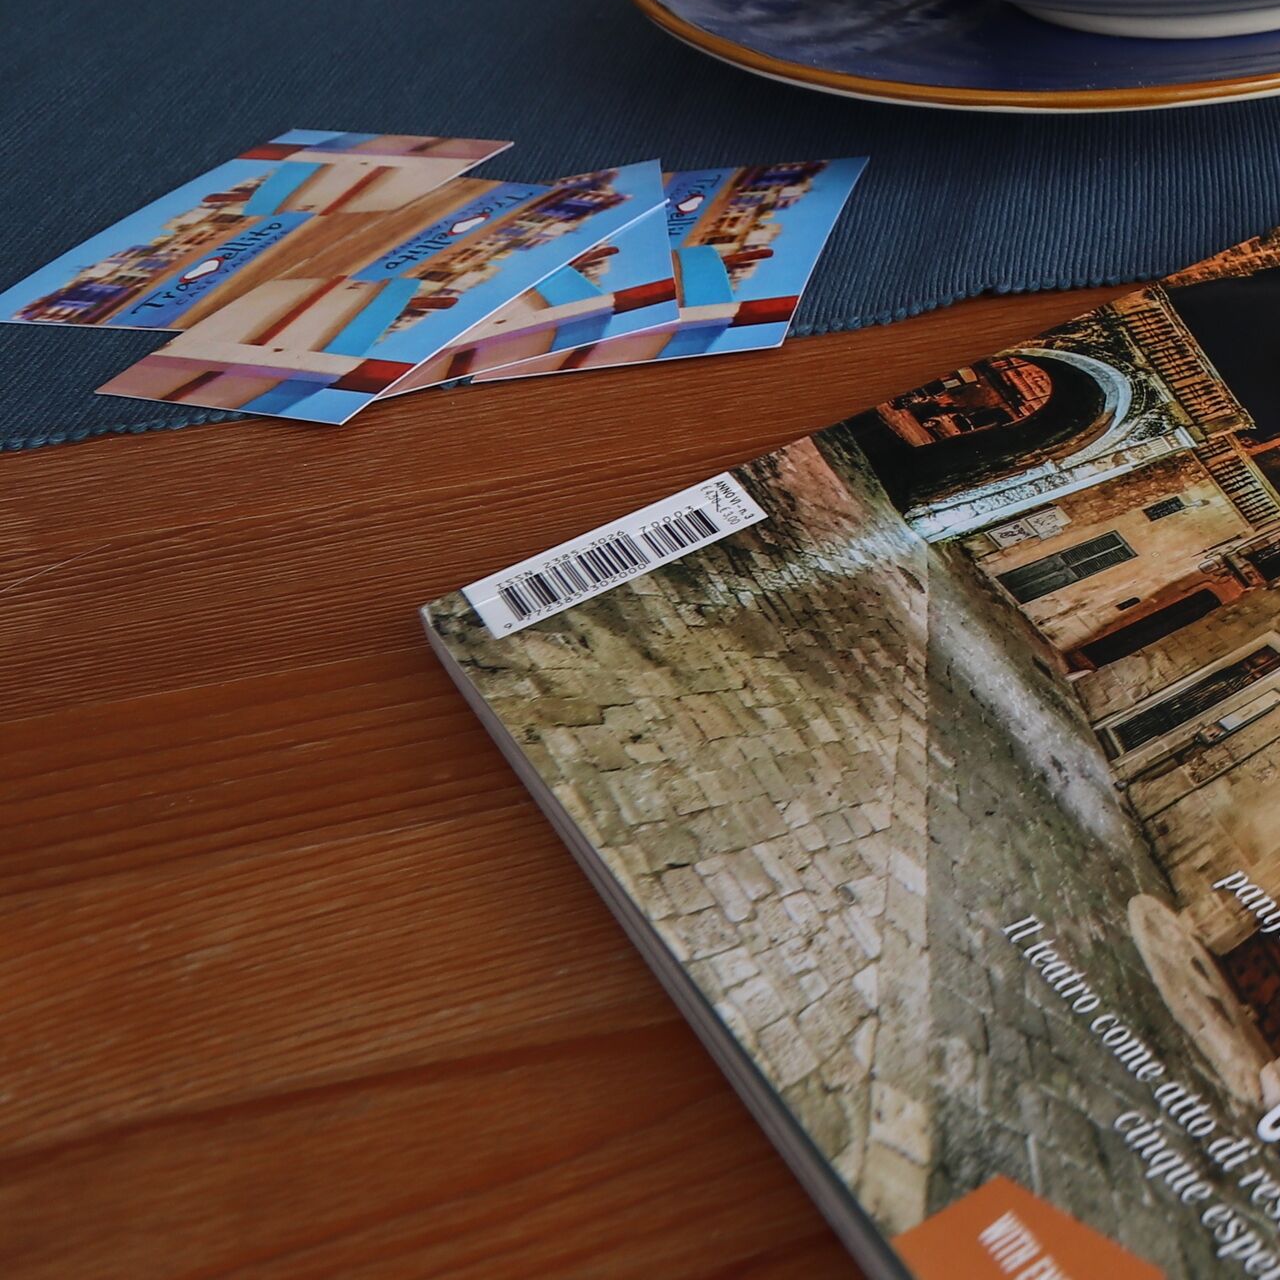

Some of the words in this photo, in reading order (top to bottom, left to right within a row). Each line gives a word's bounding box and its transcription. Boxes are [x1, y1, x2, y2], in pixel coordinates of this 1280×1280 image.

[495, 570, 535, 591] ISSN
[544, 529, 626, 569] 2385-3026
[1002, 914, 1045, 944] Il
[1024, 939, 1102, 1015] teatro
[1090, 1013, 1167, 1083] come
[1154, 1080, 1217, 1138] atto
[1206, 1134, 1262, 1172] di
[1113, 1109, 1213, 1205] cinque
[977, 1209, 1043, 1275] WITH
